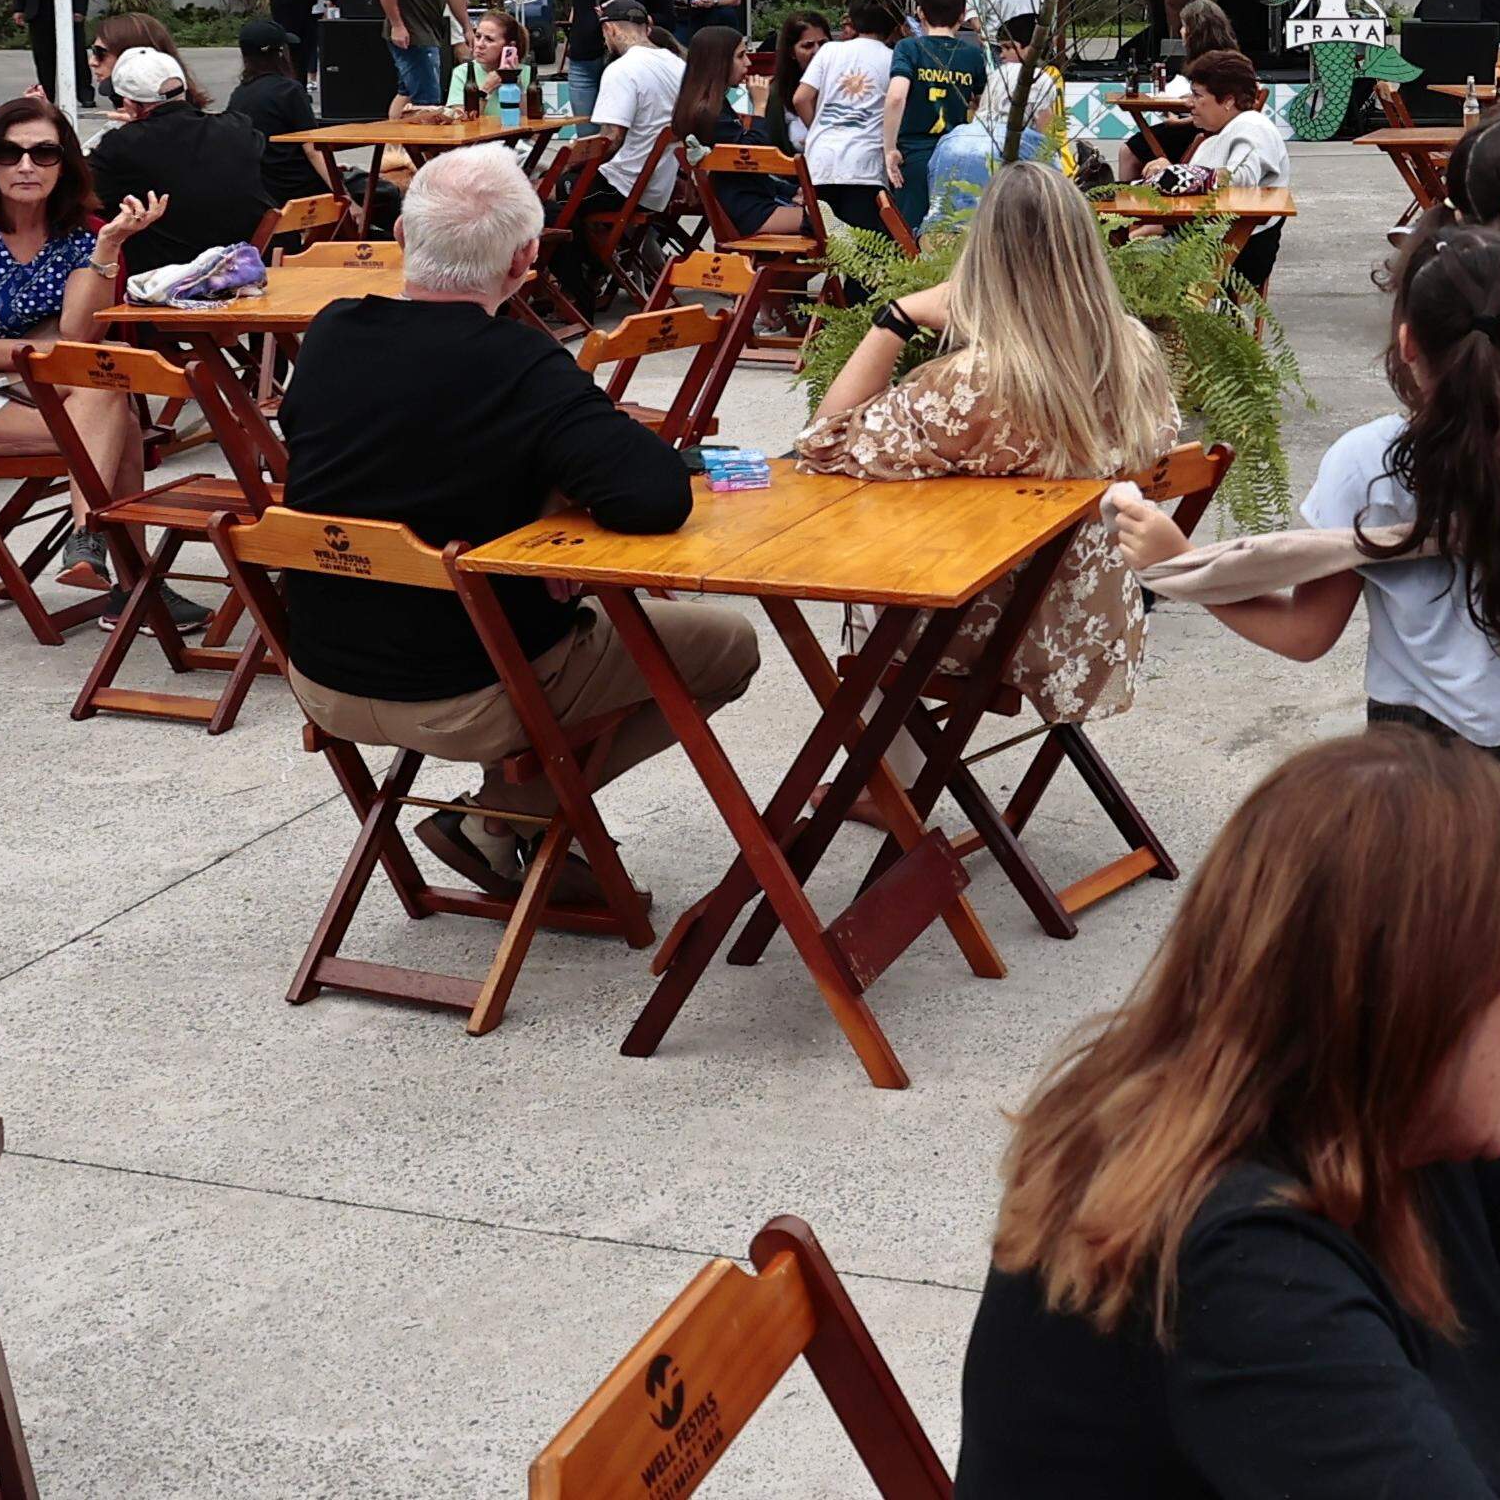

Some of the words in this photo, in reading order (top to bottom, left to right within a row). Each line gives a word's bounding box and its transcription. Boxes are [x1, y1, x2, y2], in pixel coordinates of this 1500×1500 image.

[1294, 25, 1380, 42] PRAYA
[918, 68, 972, 86] RONALDO
[313, 549, 338, 560] WELL
[339, 553, 371, 565] FESTAS
[641, 1443, 676, 1489] WELL
[675, 1391, 717, 1451] FESTAS
